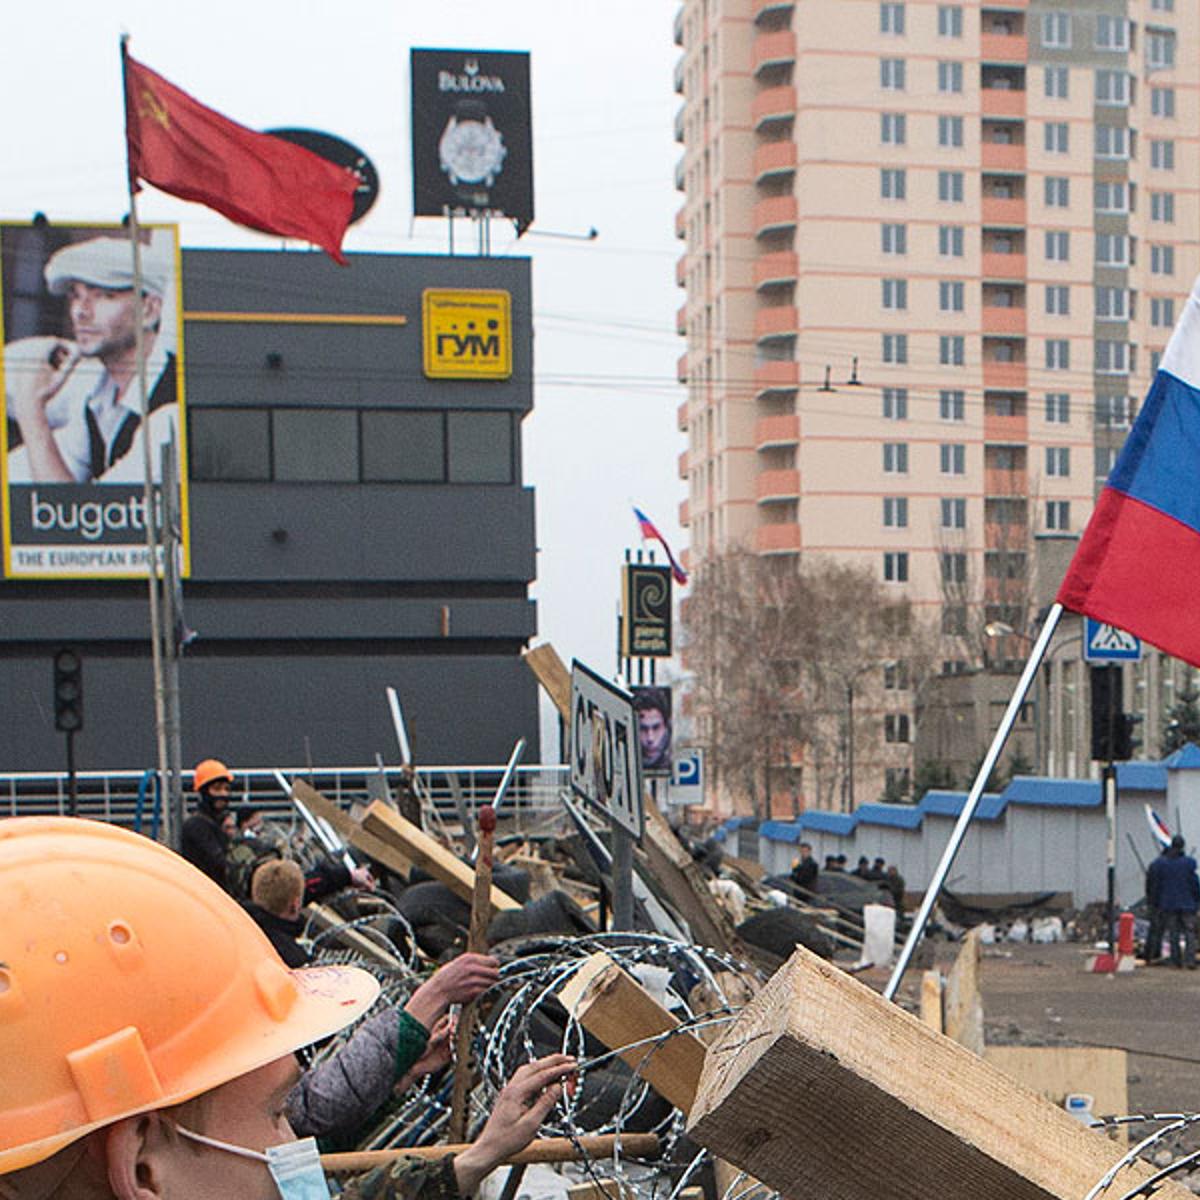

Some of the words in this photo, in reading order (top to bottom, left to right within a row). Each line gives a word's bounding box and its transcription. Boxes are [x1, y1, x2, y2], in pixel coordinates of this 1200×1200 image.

[436, 334, 499, 357] ГУМ
[18, 551, 43, 567] THE
[49, 551, 126, 567] EUROPEAN
[674, 759, 696, 785] P
